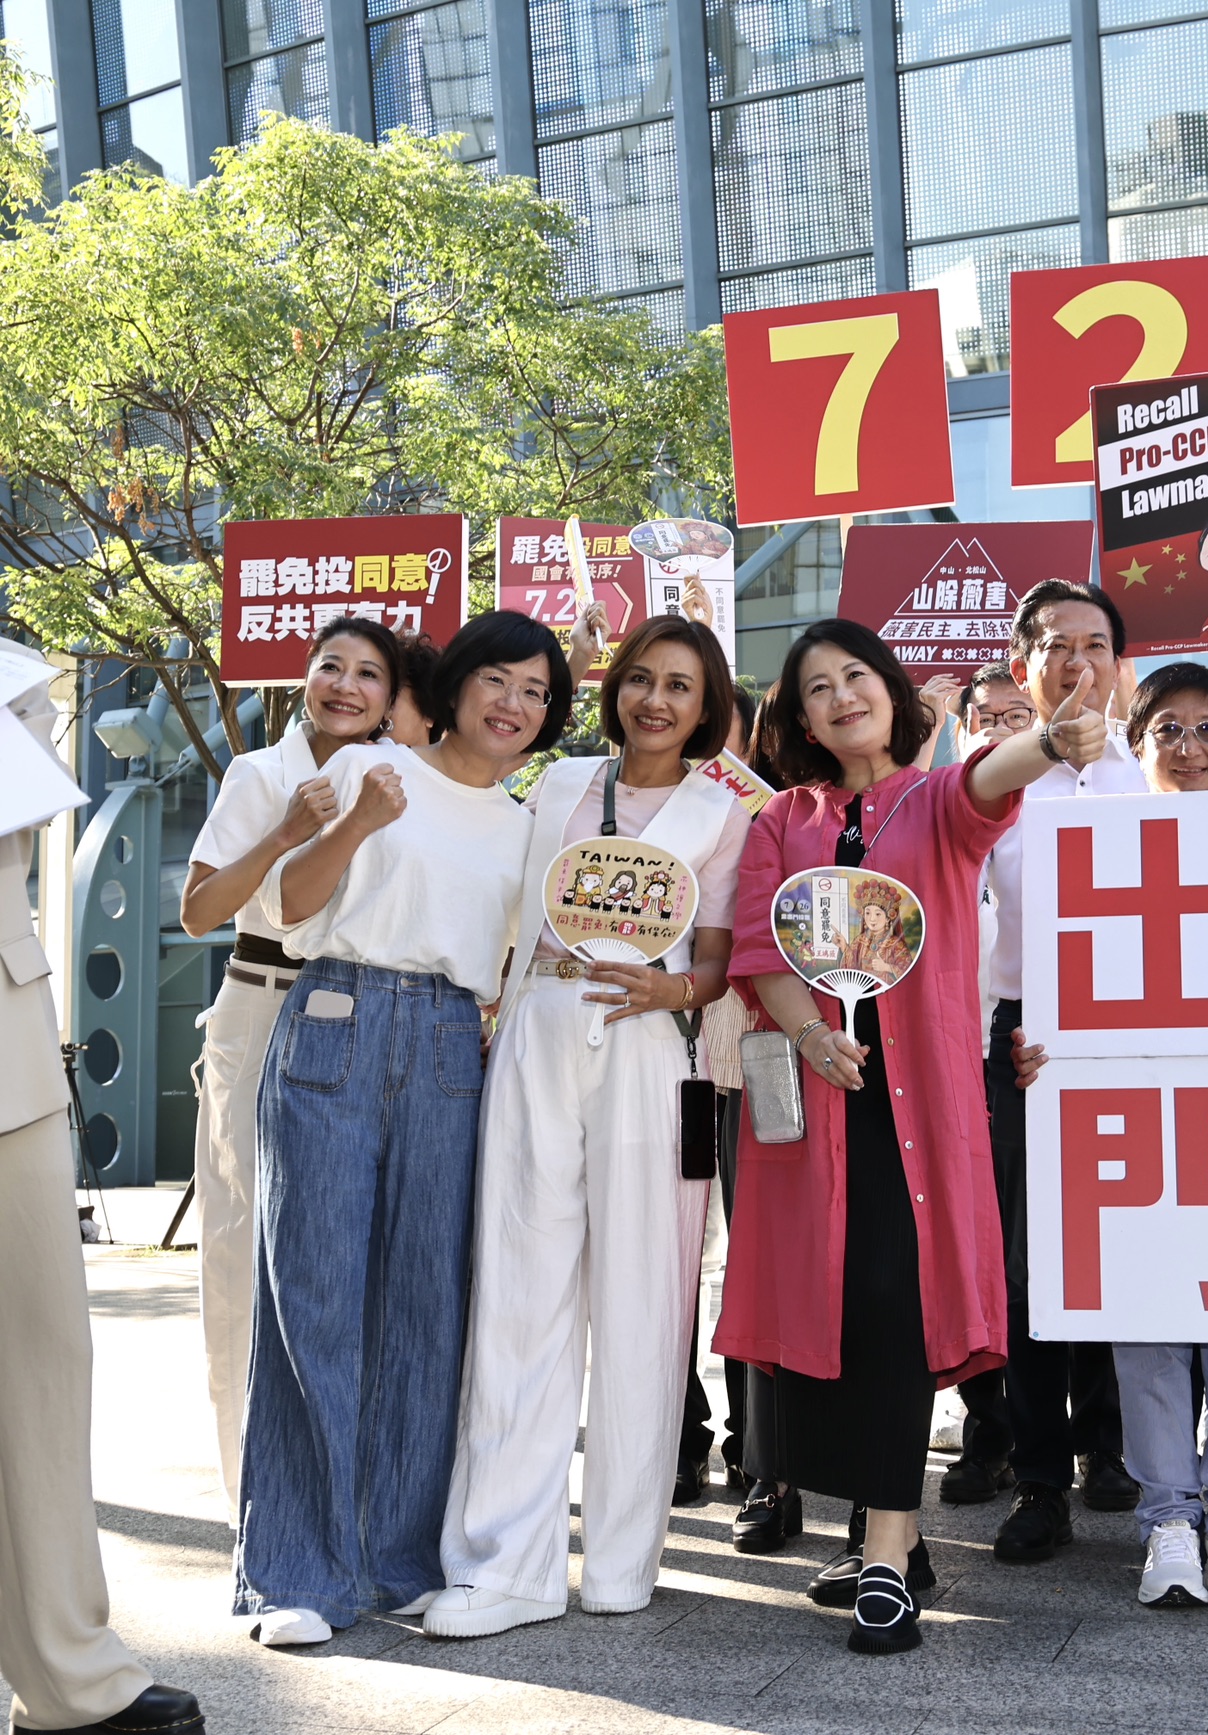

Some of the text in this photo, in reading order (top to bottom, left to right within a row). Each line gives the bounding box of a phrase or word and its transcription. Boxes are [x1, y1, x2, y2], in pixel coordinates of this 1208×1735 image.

[1052, 281, 1188, 463] 2
[769, 313, 899, 496] 7
[1117, 385, 1199, 434] Recall
[525, 588, 576, 622] 7.2
[912, 578, 1007, 611] 山除薇害
[580, 850, 675, 871] TAIWAN!
[820, 896, 832, 944] 同意罷免
